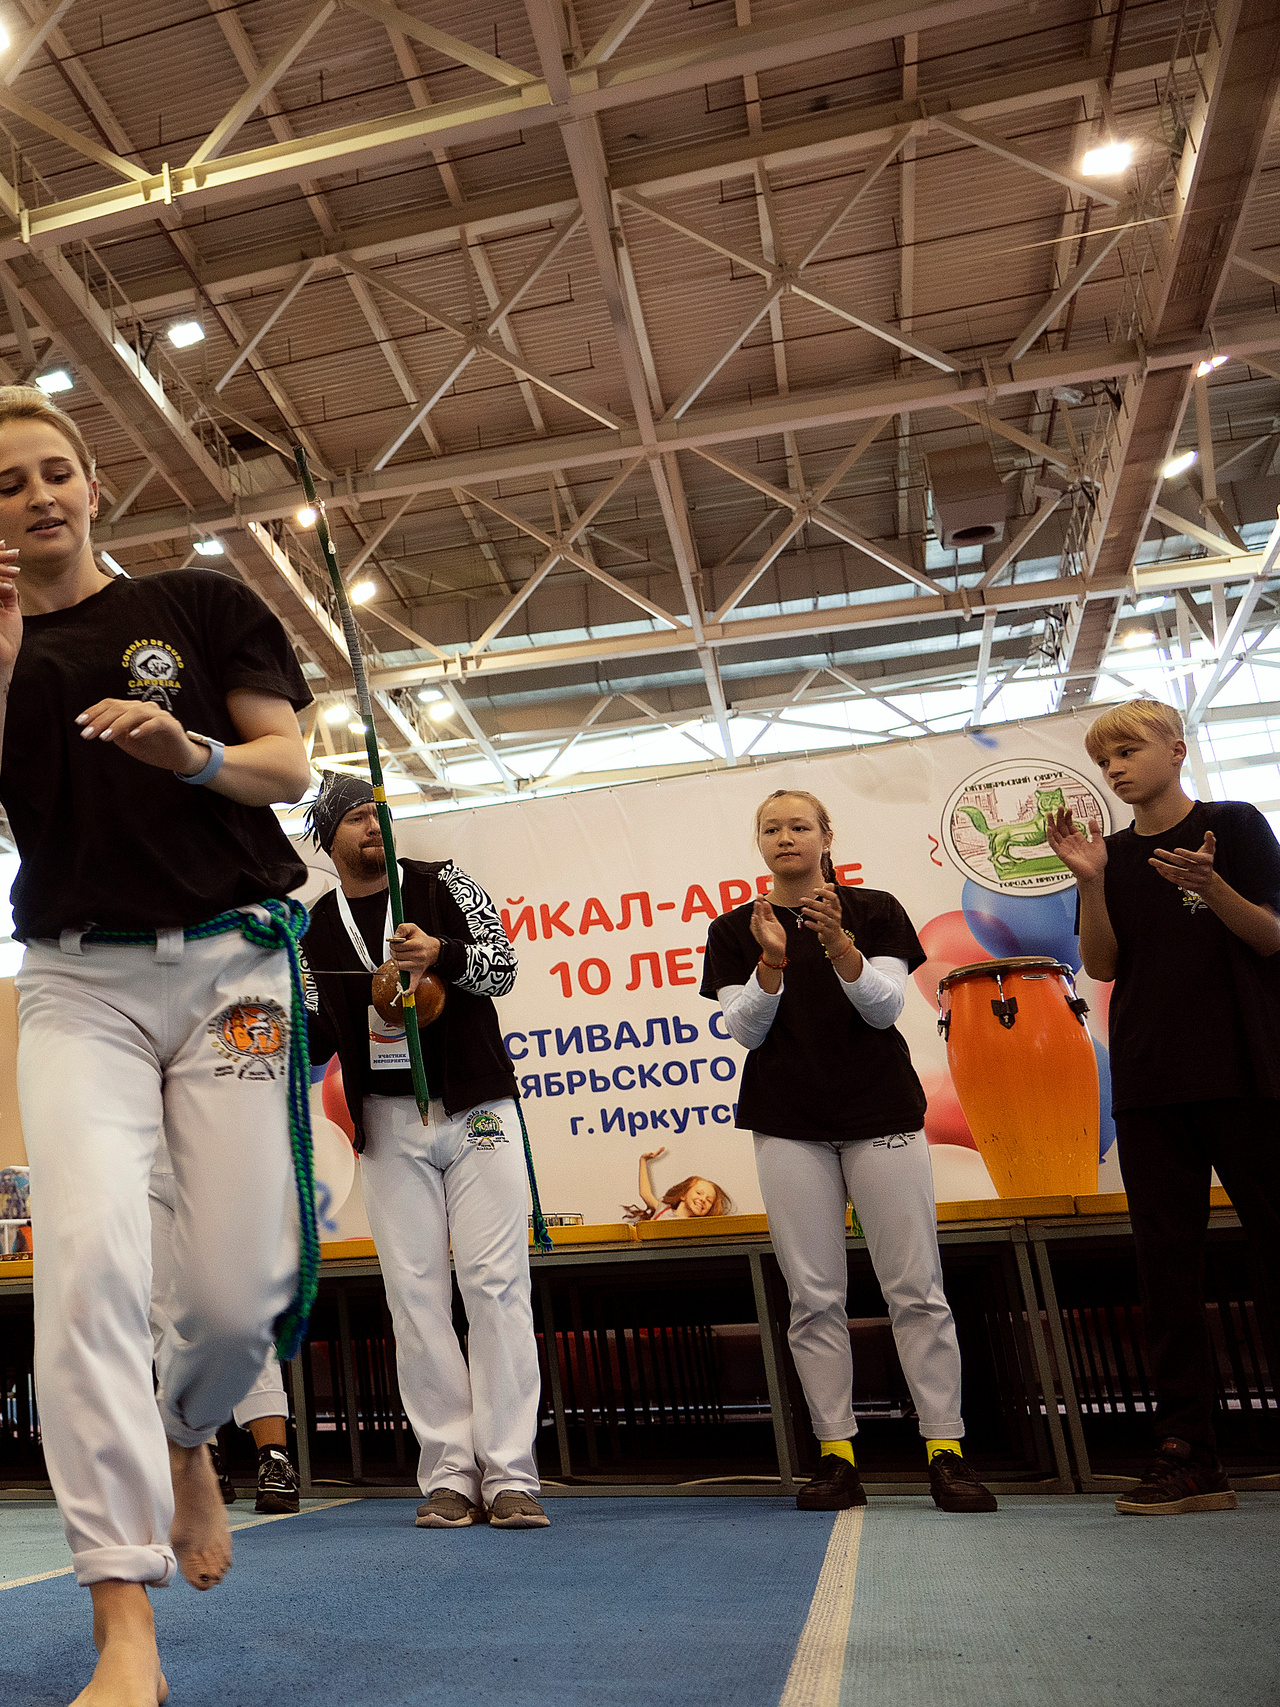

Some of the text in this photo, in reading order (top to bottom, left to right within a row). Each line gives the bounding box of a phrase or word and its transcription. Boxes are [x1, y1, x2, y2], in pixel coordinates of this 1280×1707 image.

[121, 638, 184, 669] CORDÃO DE OURO
[128, 679, 182, 689] CAPOEIRA
[1034, 771, 1063, 782] ОКРУГ
[999, 879, 1033, 888] ГОРОДА
[549, 945, 707, 998] 10 ЛЕ
[503, 1015, 699, 1060] СТИВАЛЬ
[515, 1055, 737, 1099] ЯБРЬСКОГО
